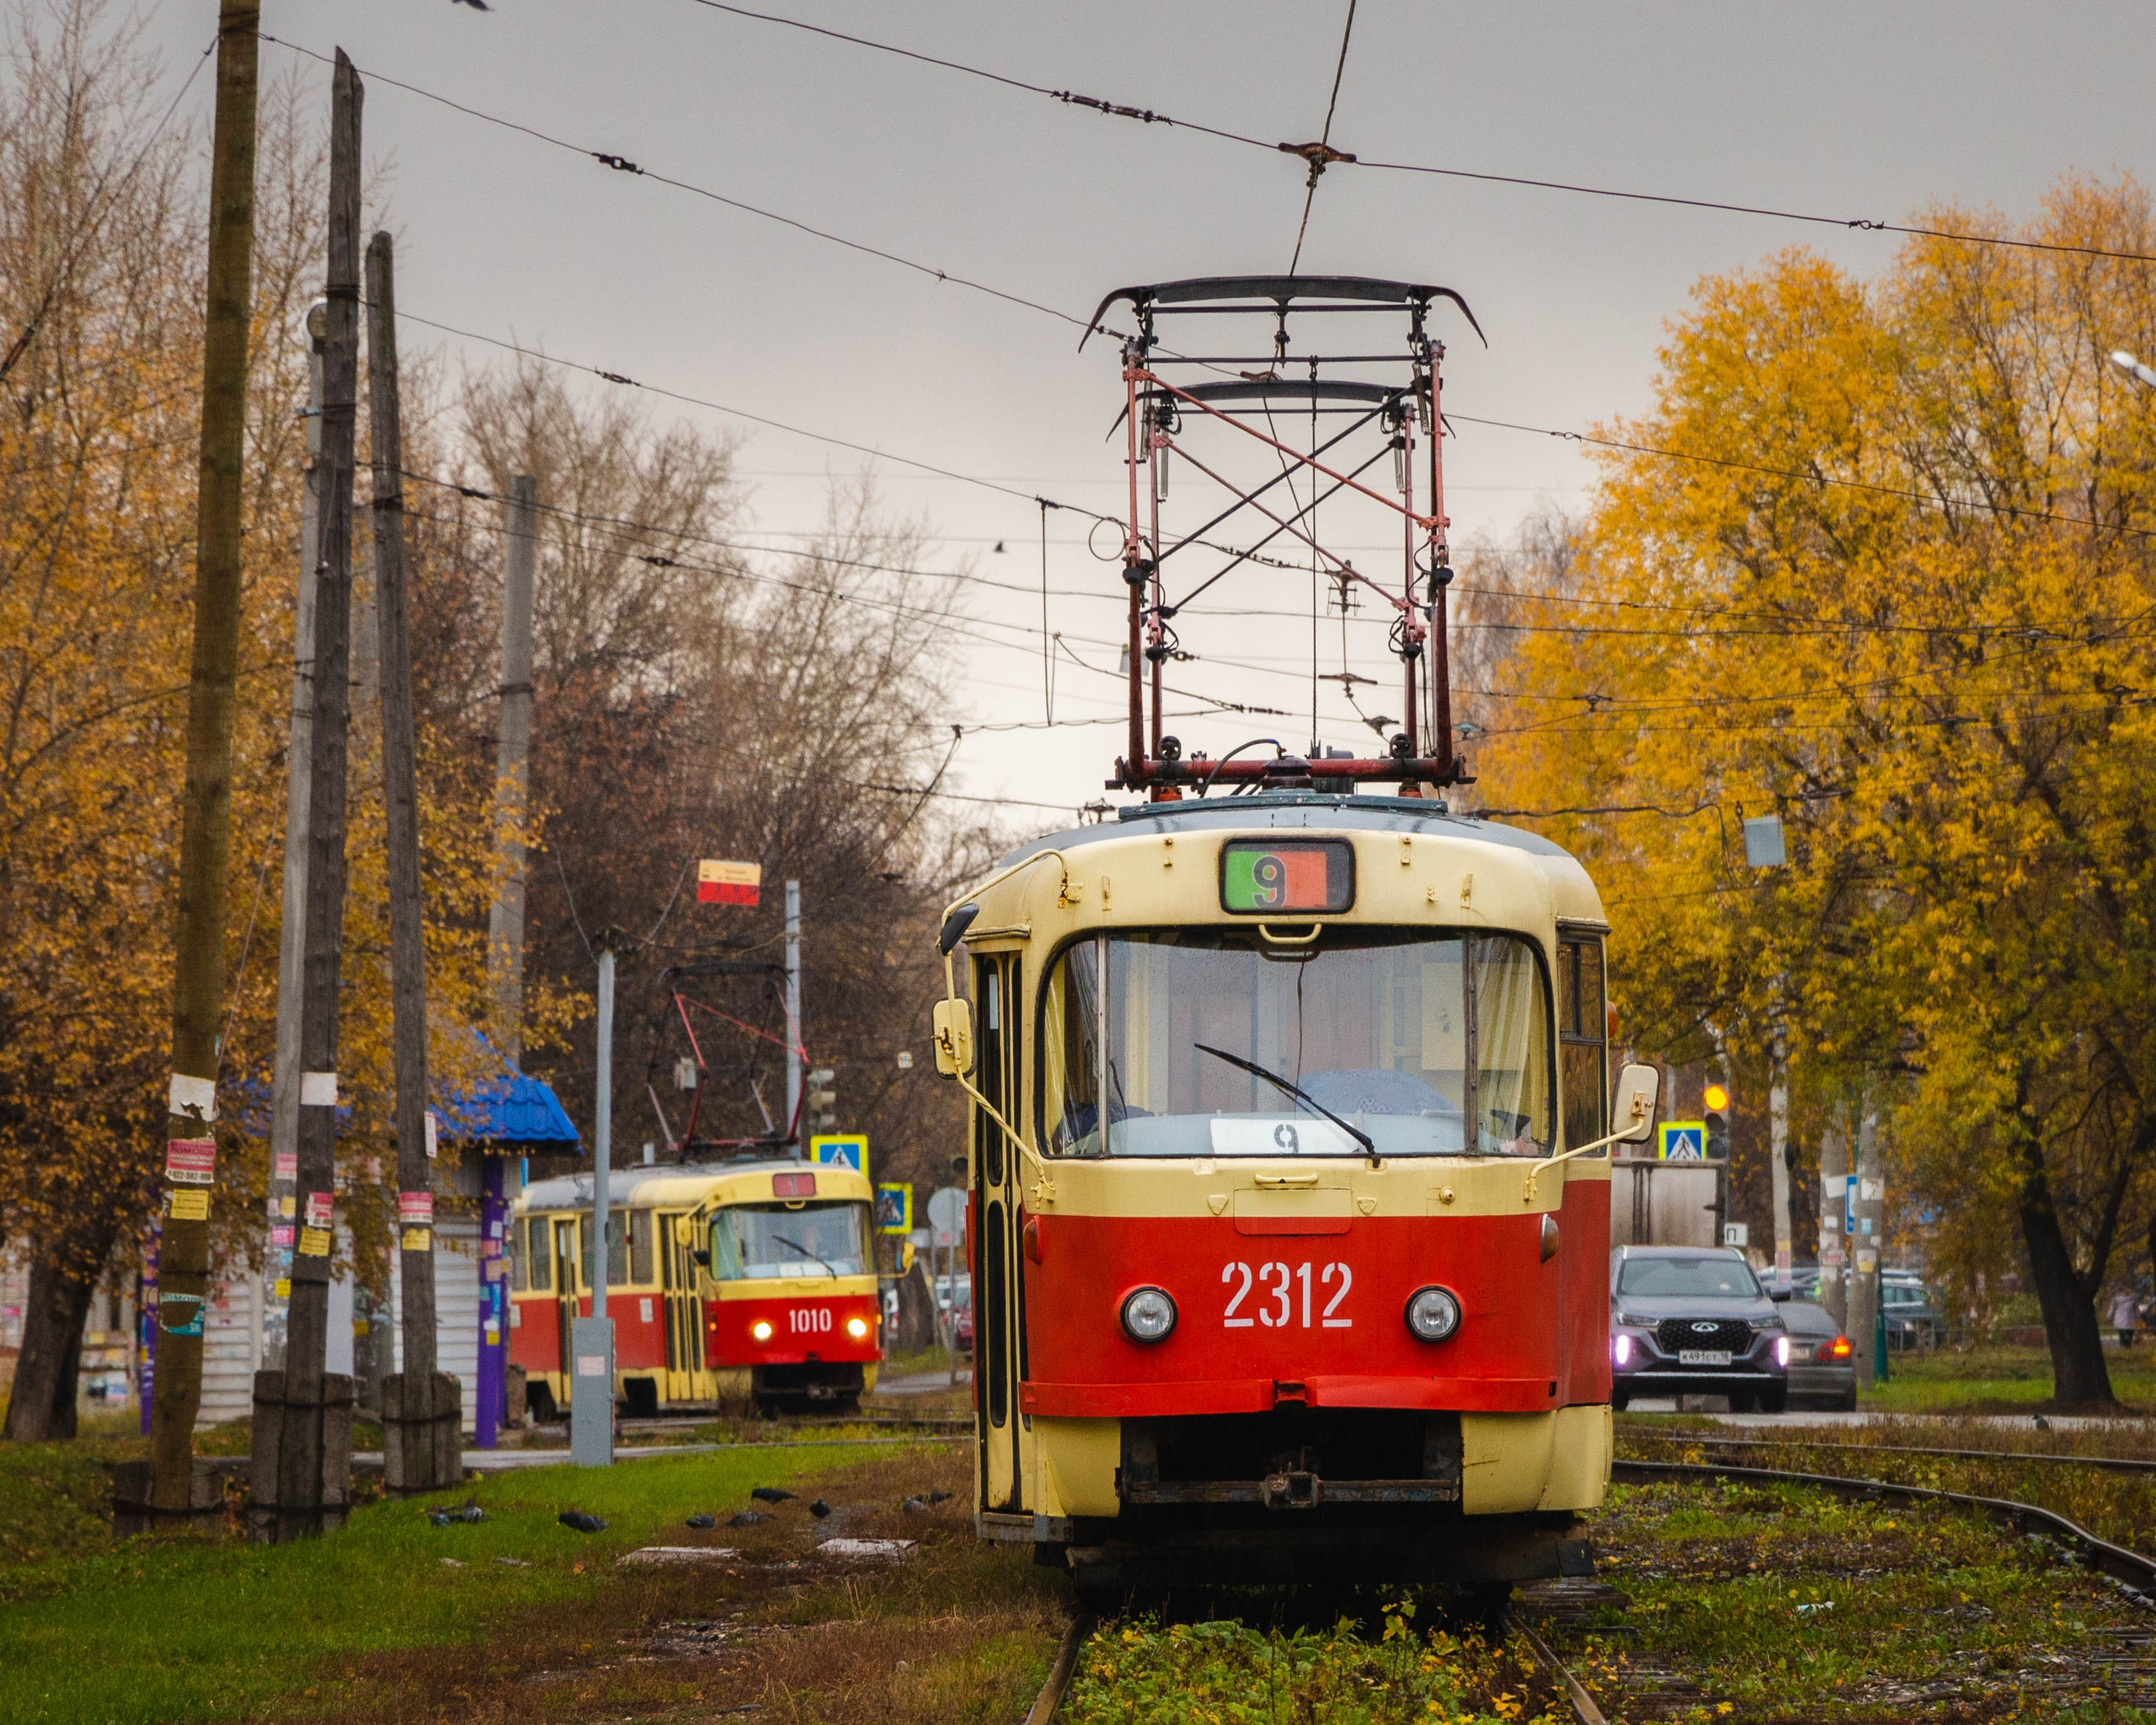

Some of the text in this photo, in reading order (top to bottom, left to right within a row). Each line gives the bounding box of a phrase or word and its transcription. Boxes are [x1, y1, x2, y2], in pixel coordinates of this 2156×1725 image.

[1251, 854, 1287, 909] 9
[1273, 1124, 1299, 1154] 9
[787, 1174, 798, 1197] 1
[1221, 1262, 1353, 1327] 2312
[789, 1308, 832, 1333] 1010
